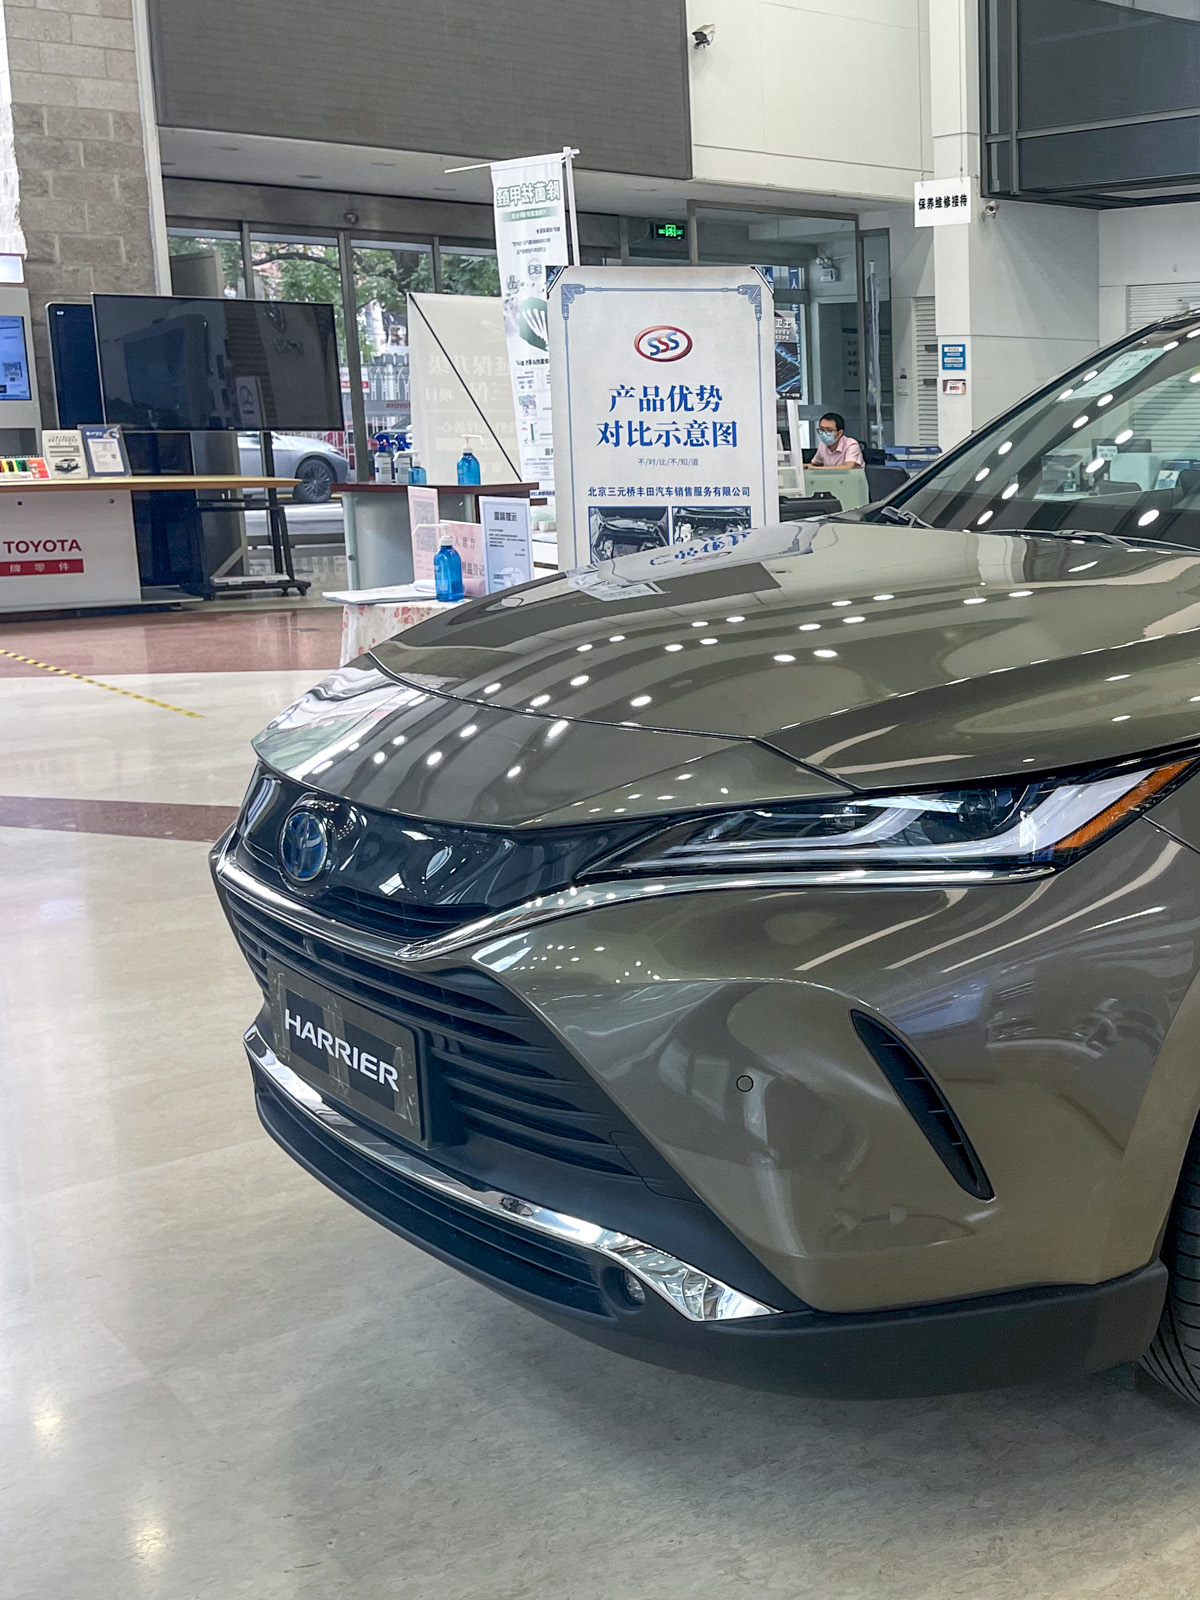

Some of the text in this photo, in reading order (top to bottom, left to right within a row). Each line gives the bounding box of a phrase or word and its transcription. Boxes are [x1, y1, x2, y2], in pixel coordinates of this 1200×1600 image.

[918, 194, 968, 210] 保养维修接待
[608, 384, 723, 412] 产品优势
[596, 420, 738, 448] 对比示意图
[588, 486, 750, 497] 北京三元桥丰田汽车销售服务有限公司
[3, 539, 82, 553] TOYOTA
[284, 1008, 400, 1092] HARRIER
